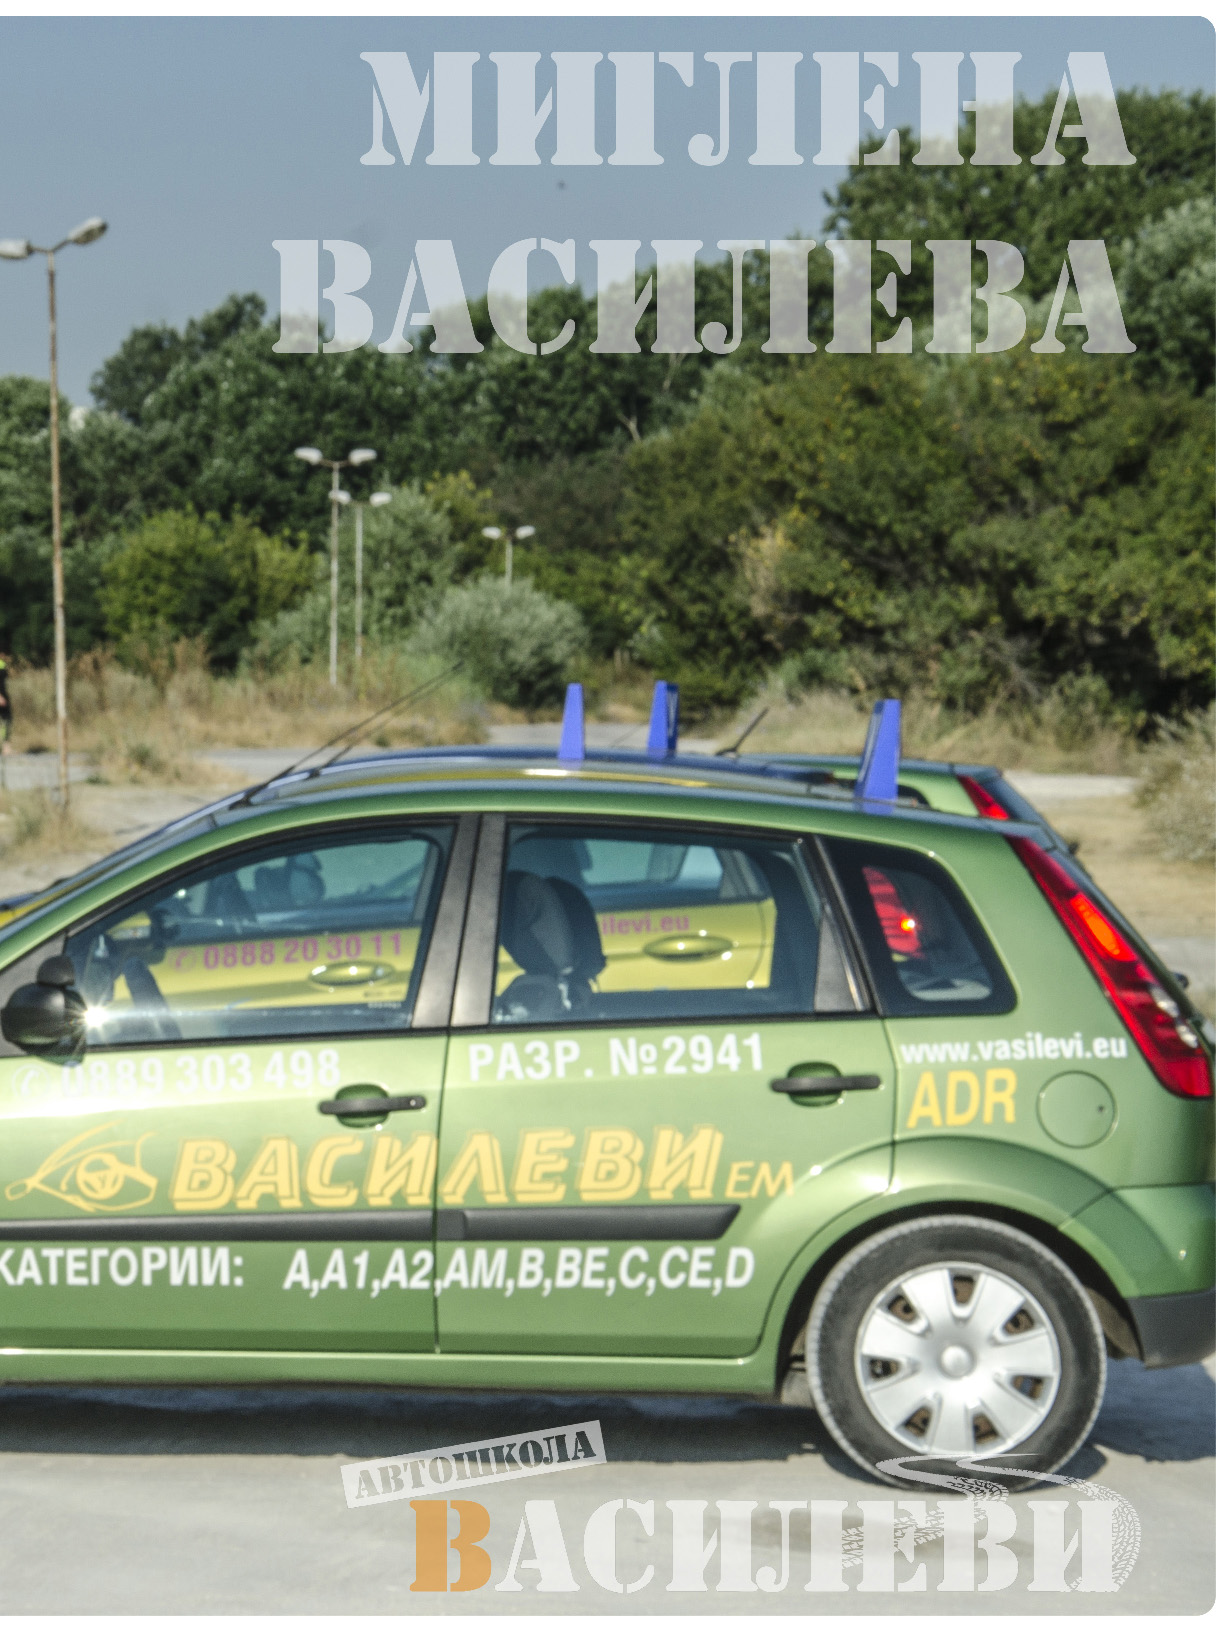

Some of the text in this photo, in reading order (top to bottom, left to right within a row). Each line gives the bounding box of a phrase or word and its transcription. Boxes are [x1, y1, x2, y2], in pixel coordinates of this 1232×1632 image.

[600, 913, 690, 935] ilevi.eu
[203, 933, 402, 969] 0888 20 30 11
[468, 1040, 593, 1082] РАЗР.
[901, 1032, 1128, 1064] www.vasilevi.eu
[61, 1049, 341, 1097] 0889 303 498
[906, 1068, 1017, 1129] ADR
[171, 1125, 724, 1212] ВАСИЛЕВИ
